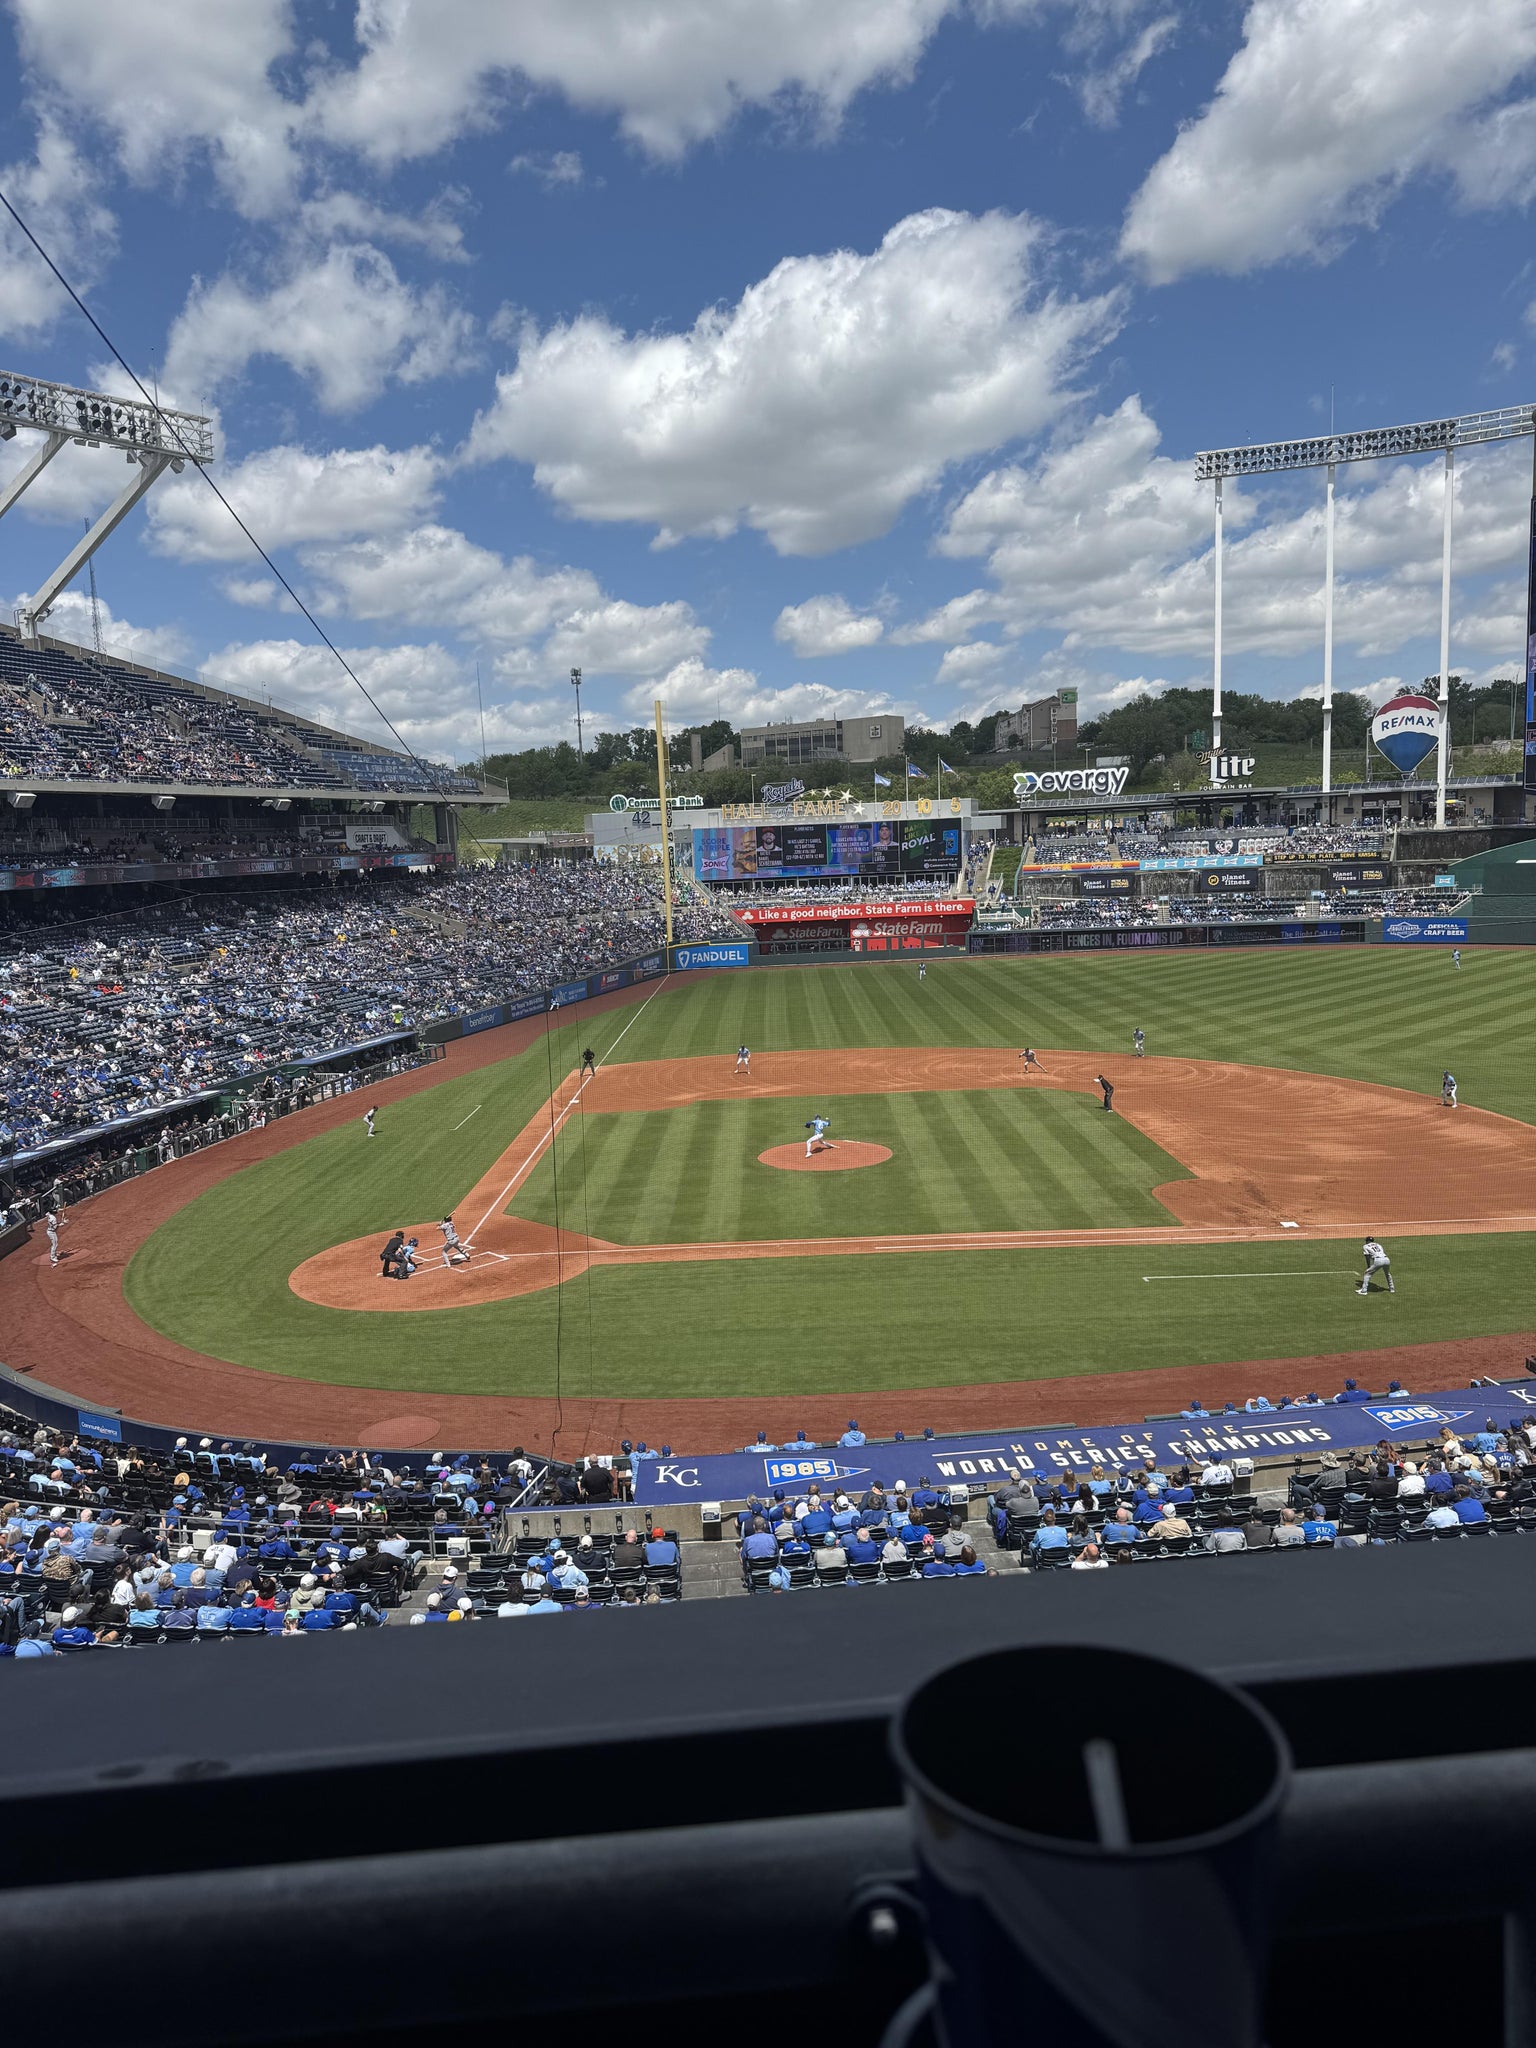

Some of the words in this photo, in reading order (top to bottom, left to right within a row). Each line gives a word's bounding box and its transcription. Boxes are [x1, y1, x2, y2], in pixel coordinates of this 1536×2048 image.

[1381, 715, 1435, 731] RE/MAX
[1196, 748, 1228, 765] Miller
[1208, 756, 1256, 783] Lite
[1040, 767, 1128, 795] evergy
[761, 778, 805, 803] Royals
[680, 797, 702, 807] Bank
[722, 804, 772, 820] HALL
[776, 805, 791, 818] of
[793, 800, 846, 817] FAME
[882, 801, 901, 815] 20
[918, 799, 931, 813] 10
[951, 797, 960, 812] 5
[632, 811, 651, 824] 42
[355, 833, 368, 843] CRAFT
[373, 833, 386, 843] DRAFT
[901, 833, 935, 851] ROYAL
[703, 860, 726, 868] SONIC
[758, 909, 779, 920] Like
[790, 908, 815, 921] good
[816, 906, 863, 919] neighbor,
[865, 905, 892, 915] State
[895, 904, 922, 914] Farm
[924, 904, 932, 912] is
[934, 902, 965, 912] there.
[1067, 934, 1100, 948] FENCES
[1102, 933, 1115, 947] IN,
[1116, 932, 1168, 946] FOUNTAINS
[1169, 931, 1183, 944] UP
[1294, 930, 1313, 938] Right
[1314, 929, 1328, 937] Call
[691, 949, 745, 964] FANDUEL
[1376, 1406, 1442, 1424] 2015
[1010, 1437, 1095, 1453] HOME
[1123, 1431, 1153, 1445] OF
[1180, 1424, 1242, 1438] THE
[936, 1454, 1035, 1476] WORLD
[1050, 1444, 1157, 1467] SERIES
[1167, 1427, 1332, 1456] CHAMPIONS
[654, 1465, 698, 1487] KC
[770, 1460, 831, 1478] 1985
[1315, 1526, 1331, 1534] PEREZ
